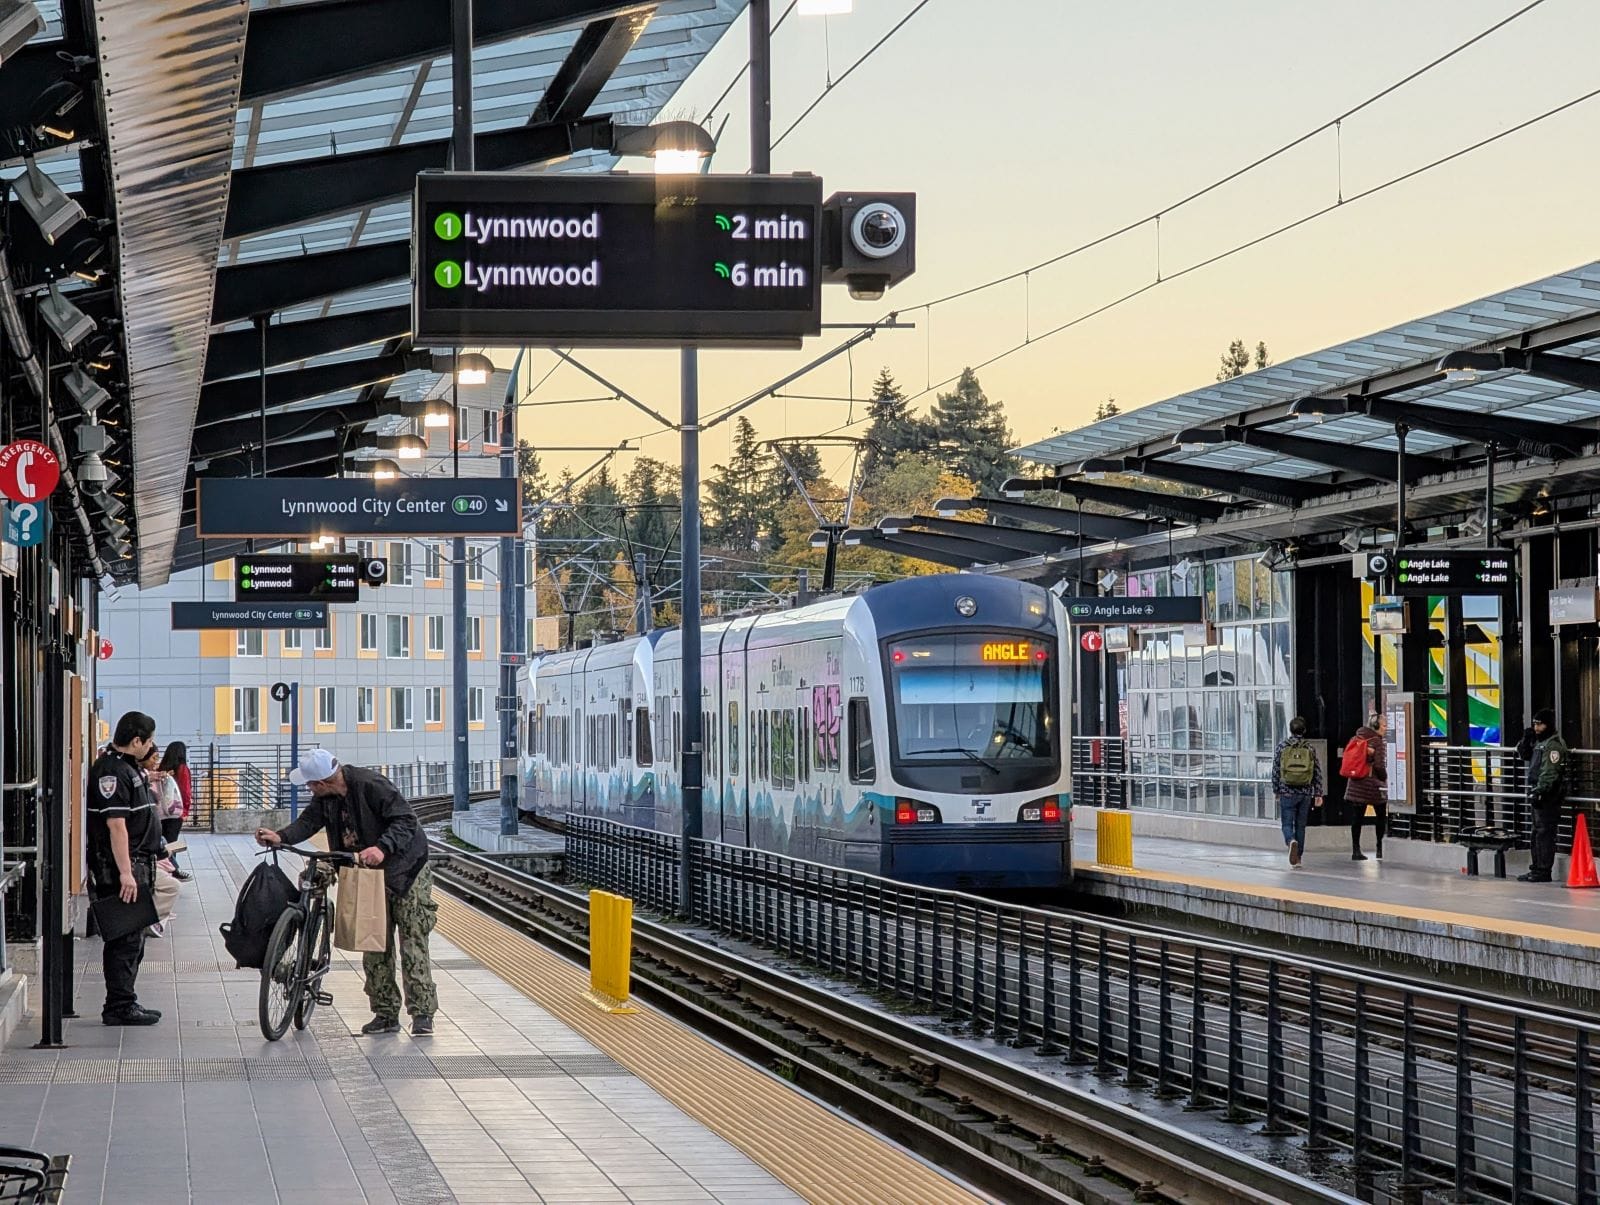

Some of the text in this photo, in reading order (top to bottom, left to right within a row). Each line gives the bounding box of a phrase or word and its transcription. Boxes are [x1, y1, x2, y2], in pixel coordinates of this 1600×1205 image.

[464, 212, 598, 243] Lynnwood
[731, 216, 748, 239] 2
[754, 215, 805, 239] min
[464, 260, 598, 291] Lynnwood
[731, 263, 747, 287] 6
[754, 262, 805, 287] min
[0, 443, 56, 468] EMERGENCY
[281, 498, 357, 517] Lynnwood
[362, 498, 391, 516] City
[396, 498, 446, 513] Center
[469, 500, 483, 510] 40
[250, 564, 292, 575] Lynnwood
[331, 565, 337, 573] 2
[338, 565, 354, 573] min
[1408, 560, 1430, 570] Angle
[1431, 560, 1450, 569] Lake
[1485, 560, 1491, 568] 3
[1491, 560, 1508, 569] min
[250, 578, 292, 590] Lynnwood
[331, 579, 337, 587] 6
[338, 579, 354, 587] min
[1408, 574, 1430, 584] Angle
[1431, 574, 1449, 582] Lake
[1481, 574, 1490, 582] 12
[1491, 574, 1507, 582] min
[212, 610, 249, 620] Lynnwood
[250, 610, 266, 620] City
[267, 610, 292, 619] Center
[1094, 606, 1120, 617] Angle
[1122, 605, 1143, 615] Lake
[983, 644, 1028, 660] ANGLE
[275, 686, 284, 699] 4
